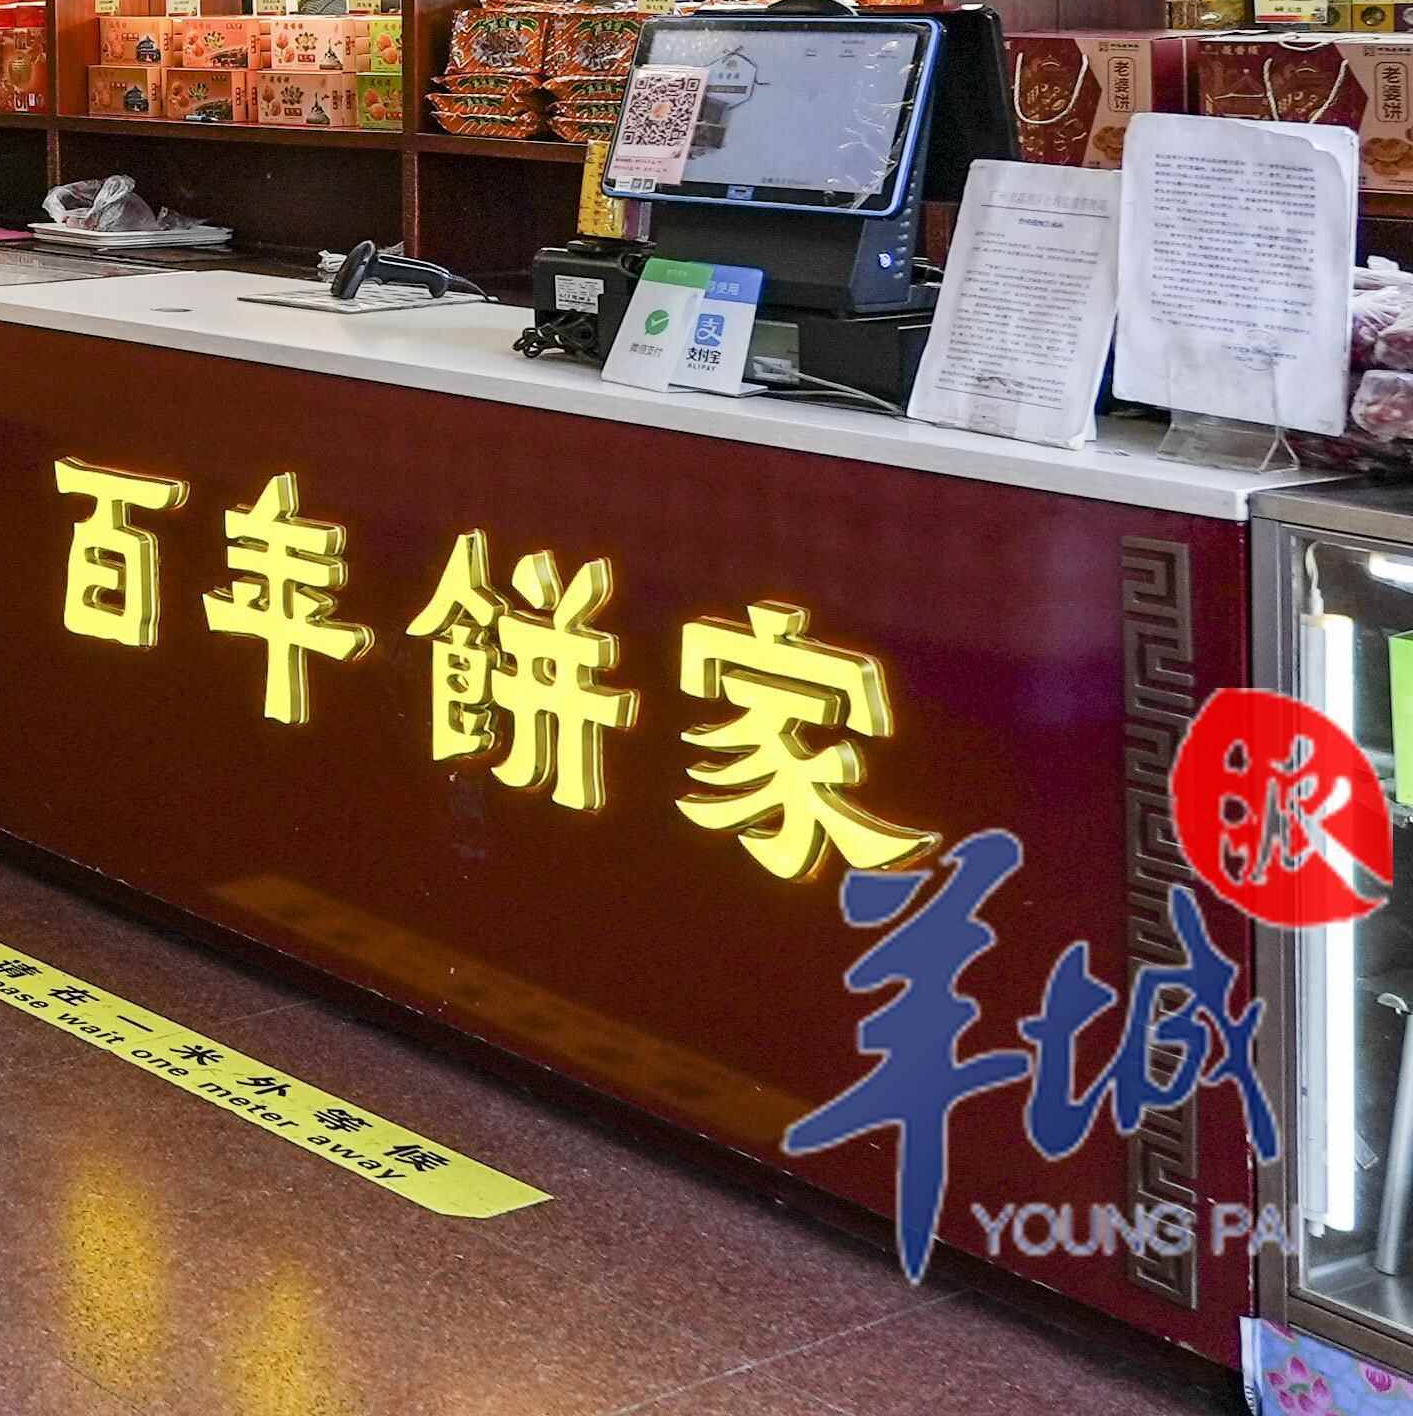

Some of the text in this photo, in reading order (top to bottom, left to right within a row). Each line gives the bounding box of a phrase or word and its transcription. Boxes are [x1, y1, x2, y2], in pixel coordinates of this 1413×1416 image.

[686, 346, 721, 365] 支付宝
[55, 456, 941, 880] 百年餅家
[55, 1009, 126, 1045] wait
[130, 1049, 190, 1078] one
[198, 1080, 299, 1129] meter
[306, 1133, 408, 1182] away
